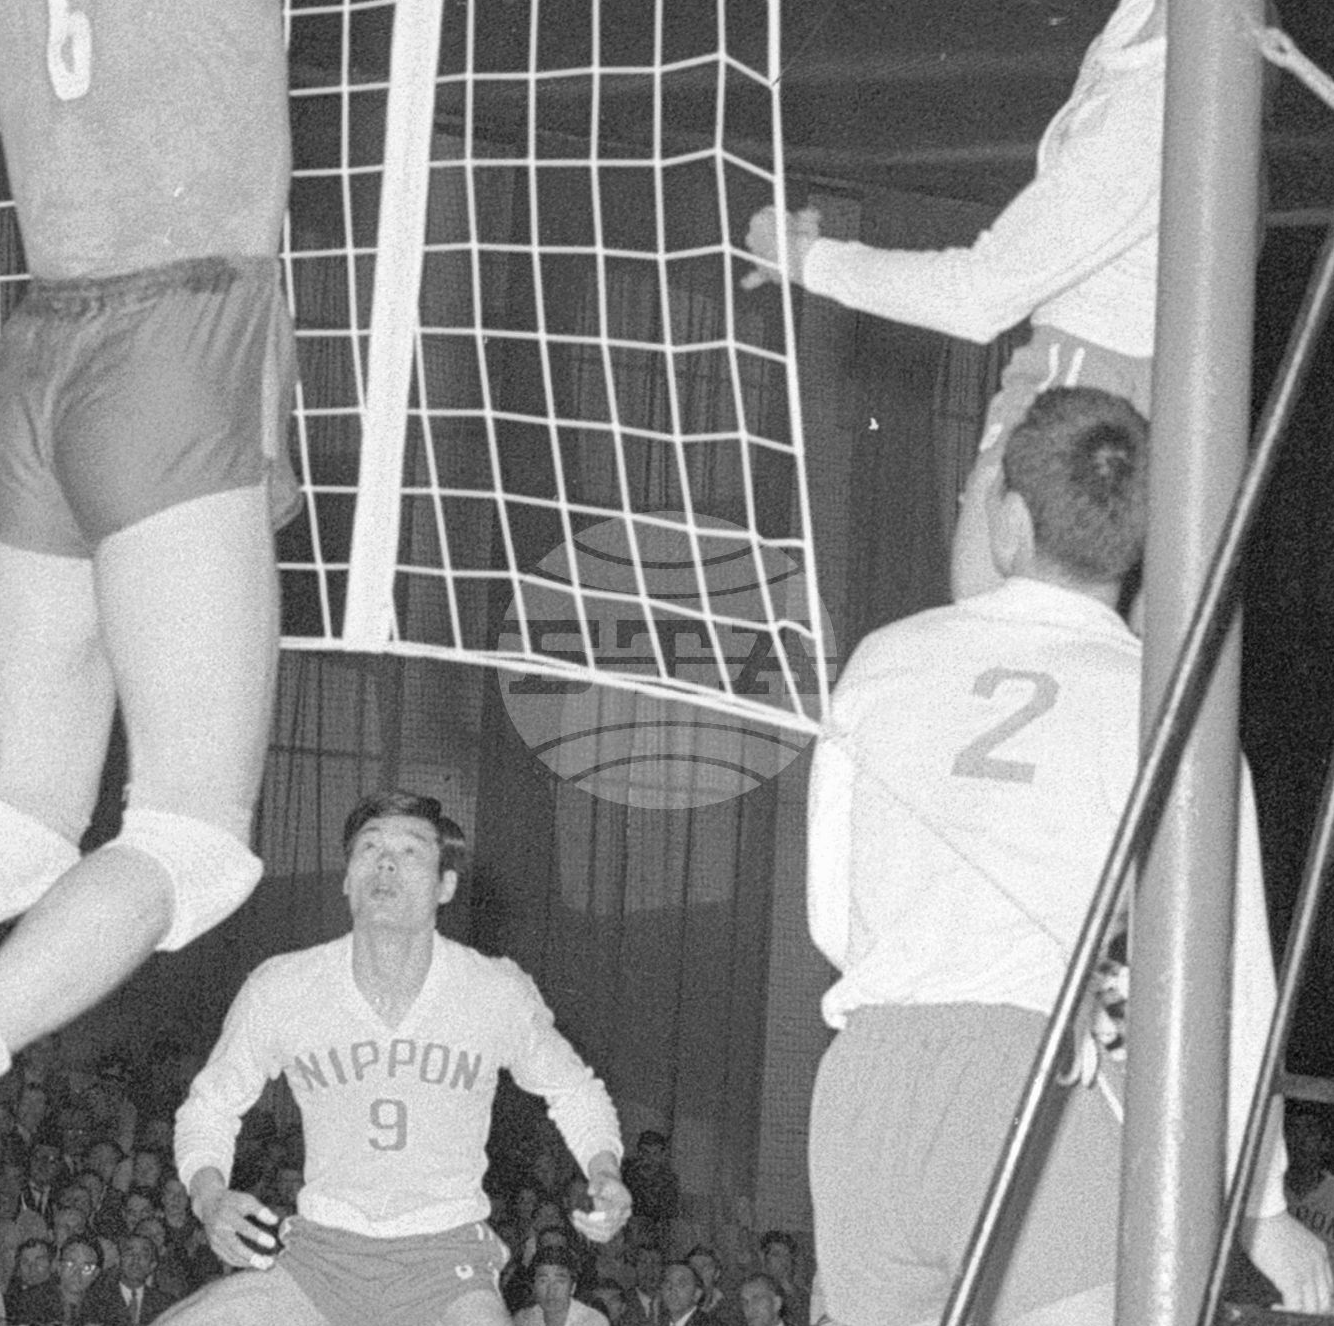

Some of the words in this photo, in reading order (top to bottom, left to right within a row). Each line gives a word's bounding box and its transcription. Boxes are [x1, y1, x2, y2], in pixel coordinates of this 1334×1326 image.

[950, 667, 1060, 784] 2
[294, 1039, 482, 1091] NIPPON
[368, 1098, 408, 1151] 9
